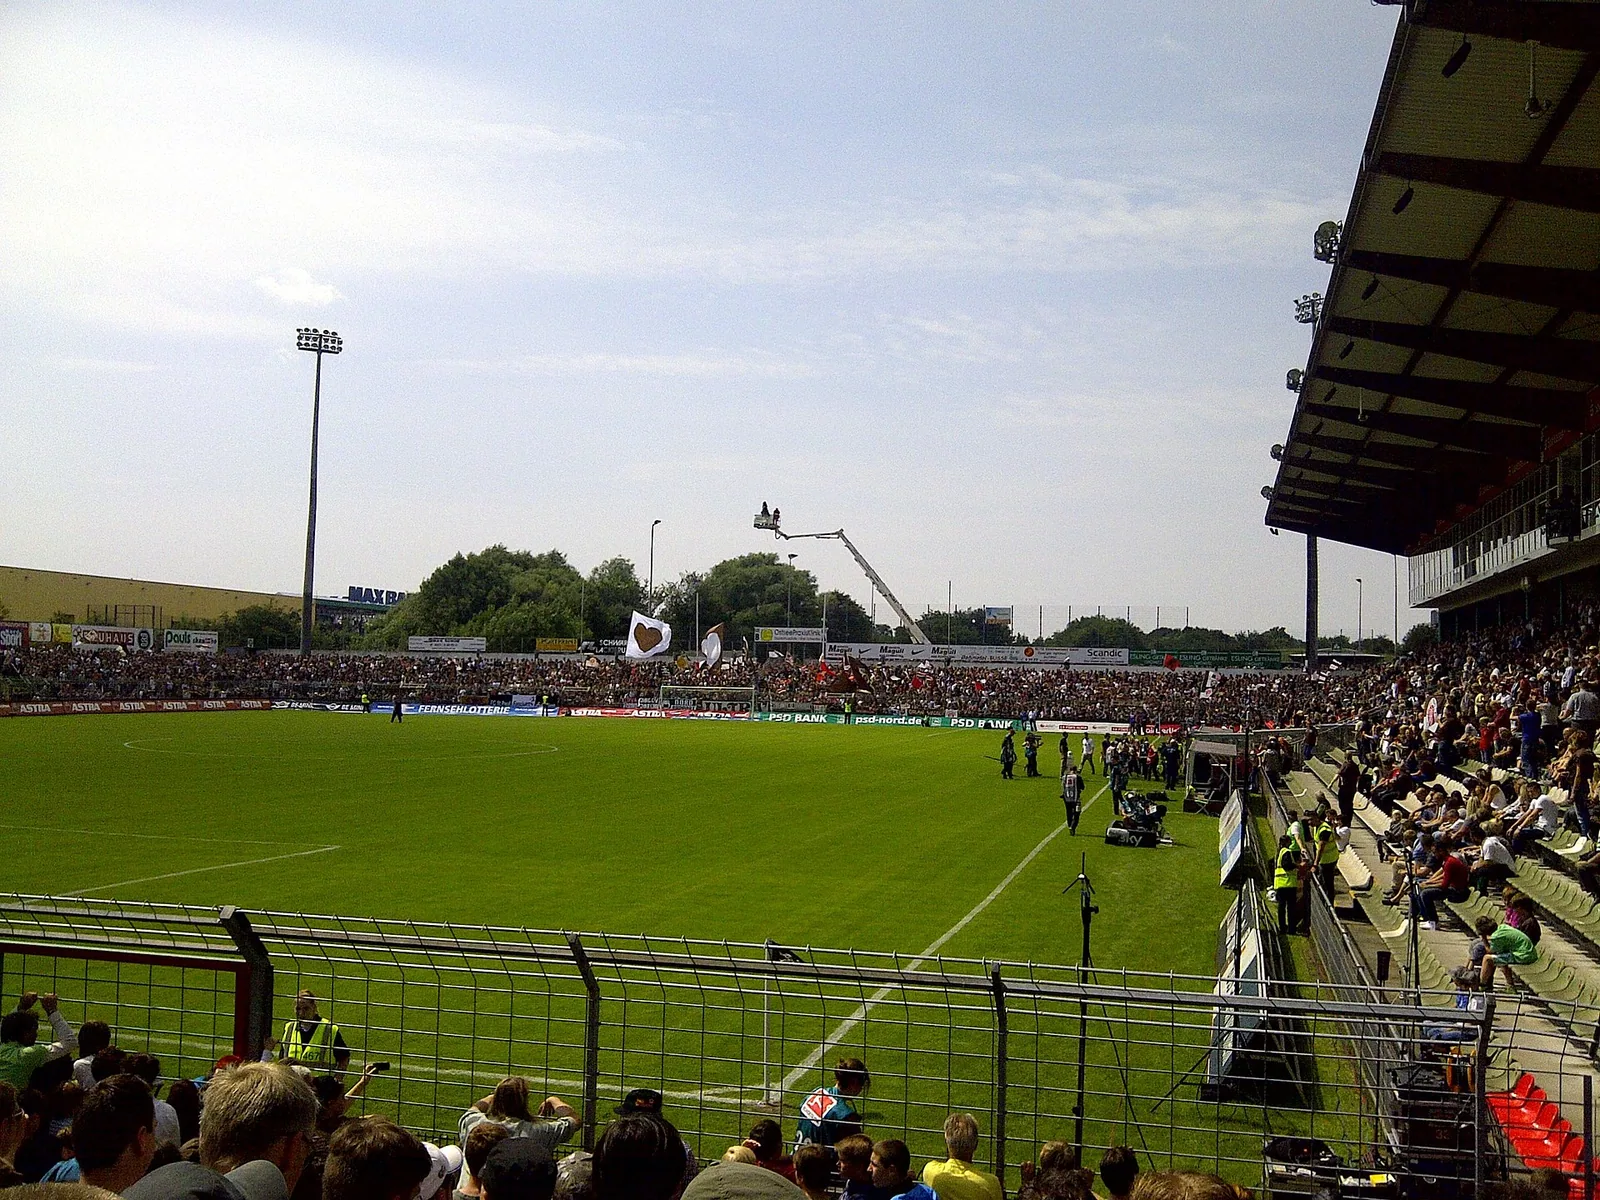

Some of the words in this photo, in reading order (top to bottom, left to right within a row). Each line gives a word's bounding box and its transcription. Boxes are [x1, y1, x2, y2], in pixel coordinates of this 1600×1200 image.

[348, 586, 385, 604] MAX
[386, 591, 406, 606] BA
[1087, 648, 1122, 658] Scandic
[20, 704, 51, 712] ASTRA
[72, 703, 100, 711] ASTRA
[119, 702, 145, 710] ASTRA
[419, 705, 510, 714] FERNSEHLOTTERIE
[769, 714, 792, 722] PSD
[794, 714, 828, 723] BANK
[855, 714, 922, 725] psd-nord.de
[950, 718, 975, 727] PSD
[302, 1051, 320, 1061] 467
